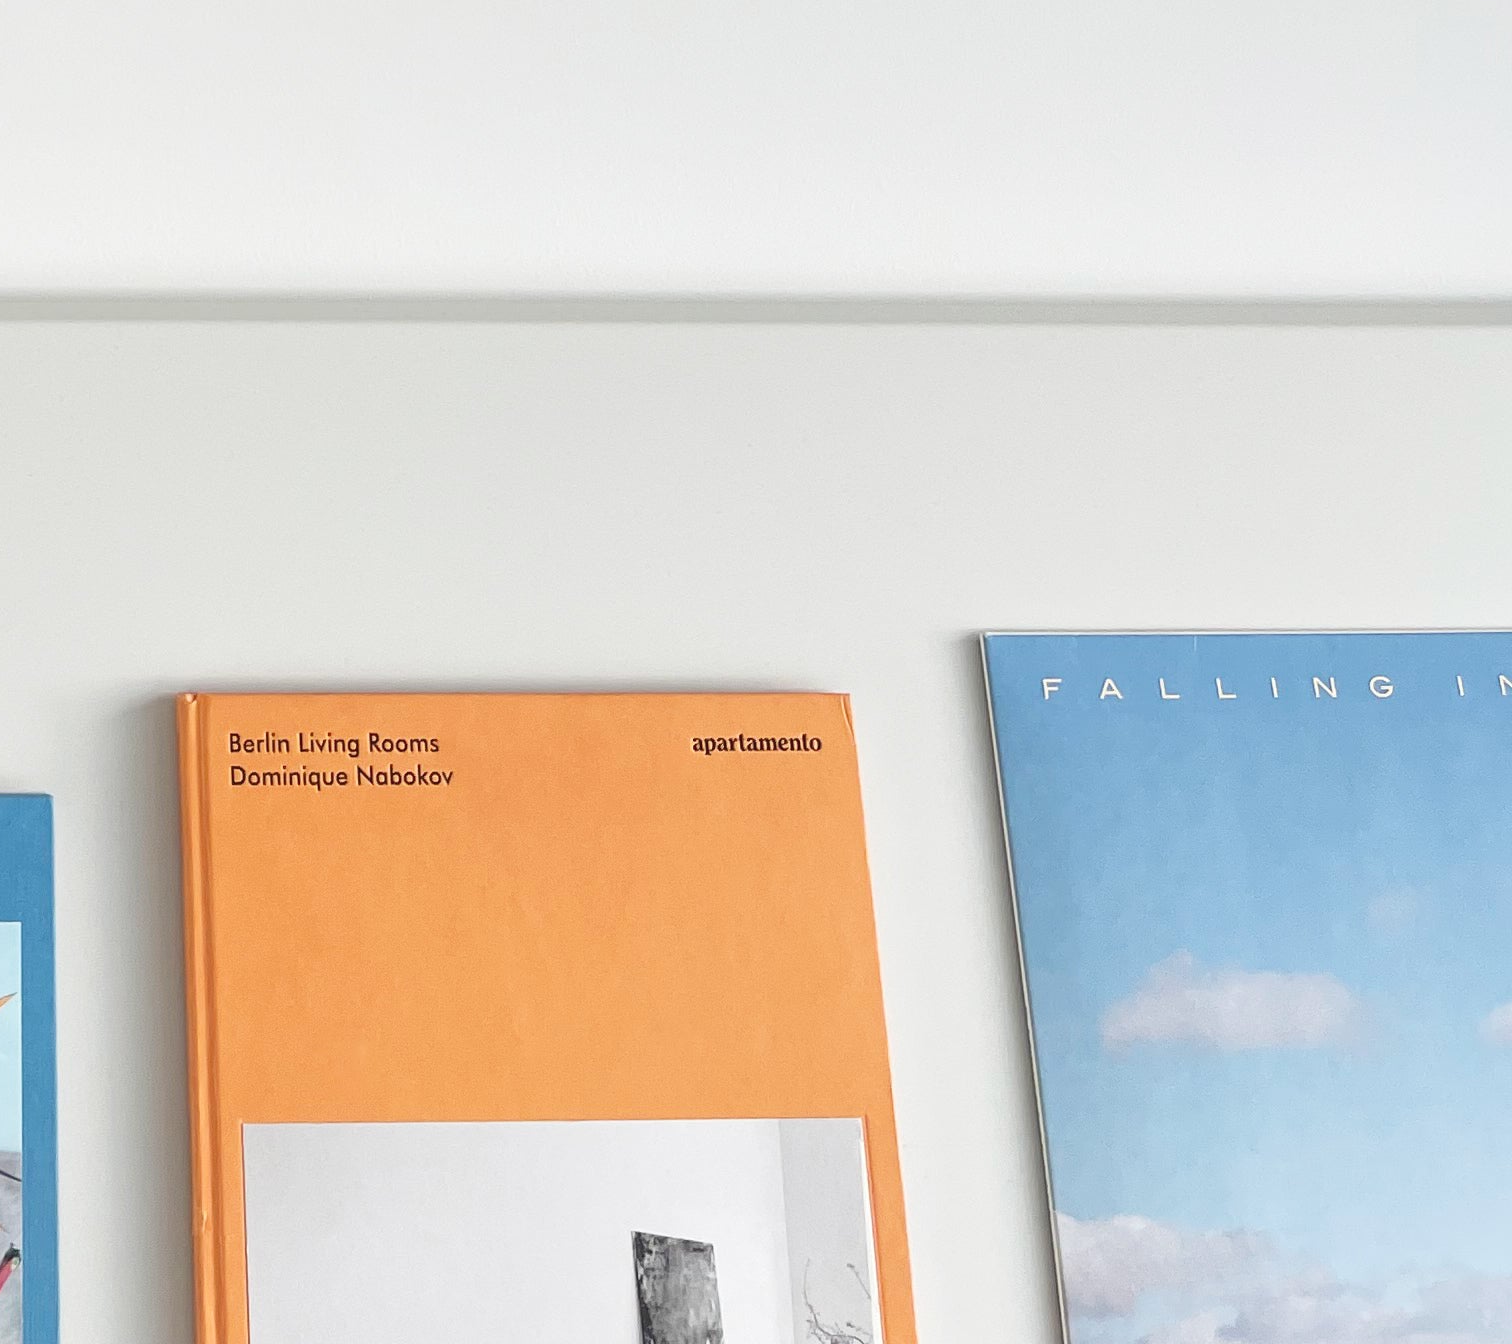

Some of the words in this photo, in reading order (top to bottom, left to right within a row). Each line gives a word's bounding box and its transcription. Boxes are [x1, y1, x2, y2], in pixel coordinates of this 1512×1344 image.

[1041, 676, 1393, 699] FALLING
[230, 732, 289, 753] Berlin
[299, 732, 359, 757] Living
[369, 733, 439, 752] Rooms
[693, 734, 822, 755] apartamento
[231, 766, 348, 791] Dominique
[357, 764, 453, 785] Nabokov
